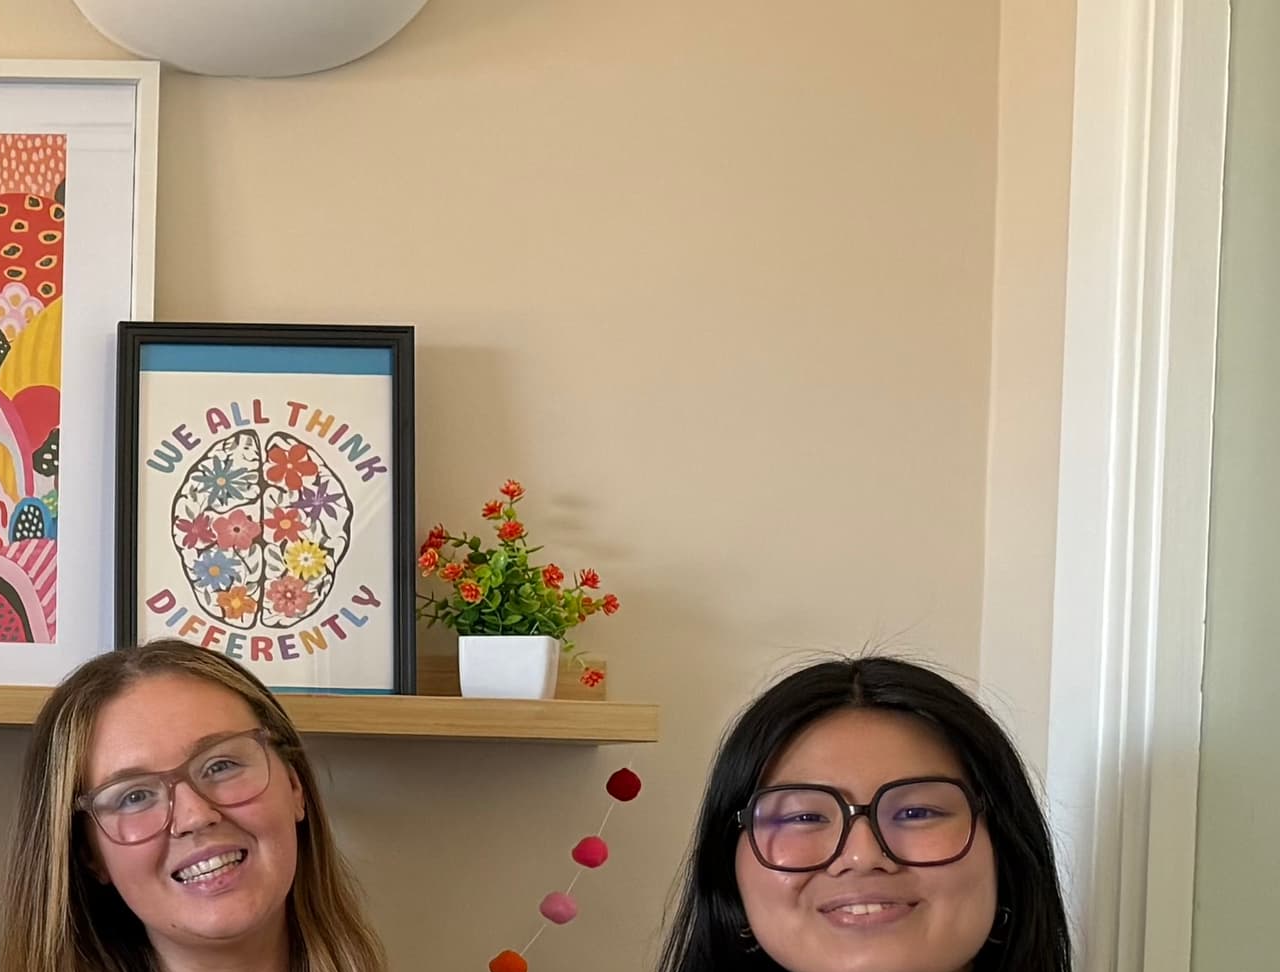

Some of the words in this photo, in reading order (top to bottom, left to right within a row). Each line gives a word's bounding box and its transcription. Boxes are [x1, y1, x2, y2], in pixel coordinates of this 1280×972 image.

[146, 424, 201, 474] WE
[205, 399, 270, 434] ALL
[286, 401, 388, 482] THINK
[146, 585, 381, 662] DIFFERENTLY
